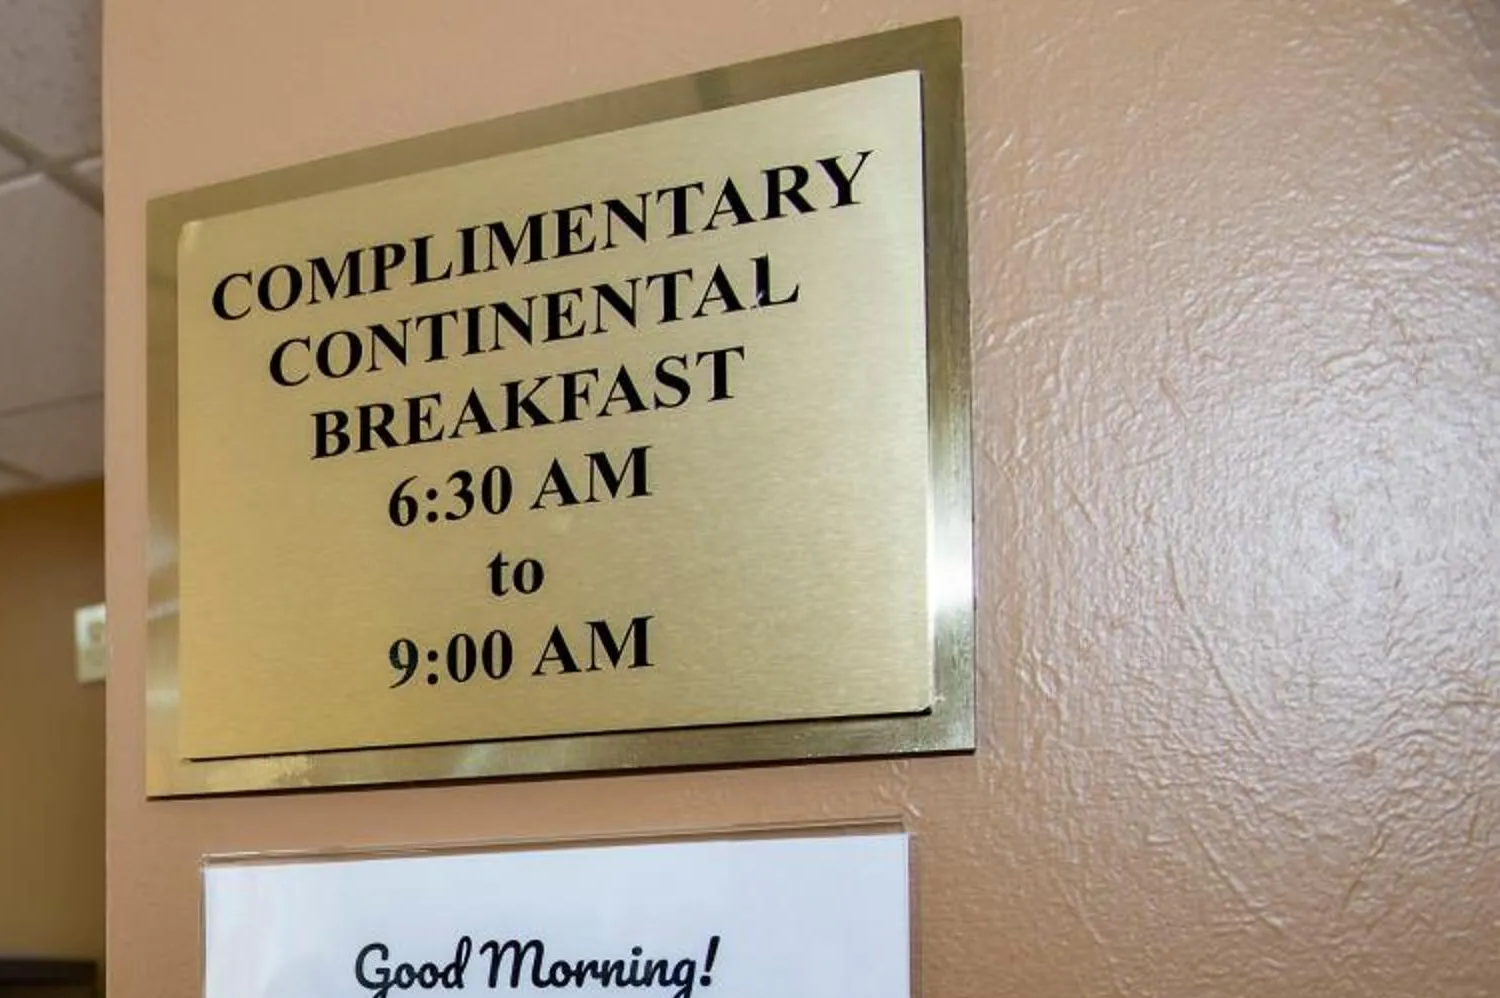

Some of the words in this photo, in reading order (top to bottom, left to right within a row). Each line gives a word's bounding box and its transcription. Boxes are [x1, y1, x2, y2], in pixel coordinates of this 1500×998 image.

[211, 151, 871, 321] COMPLIMENTARY
[269, 255, 799, 387] CONTINENTAL
[311, 346, 745, 459] BREAKFAST
[388, 465, 513, 527] 6:30
[530, 445, 651, 510] AM
[487, 552, 545, 597] to
[389, 629, 513, 689] 9:00
[531, 615, 654, 676] AM
